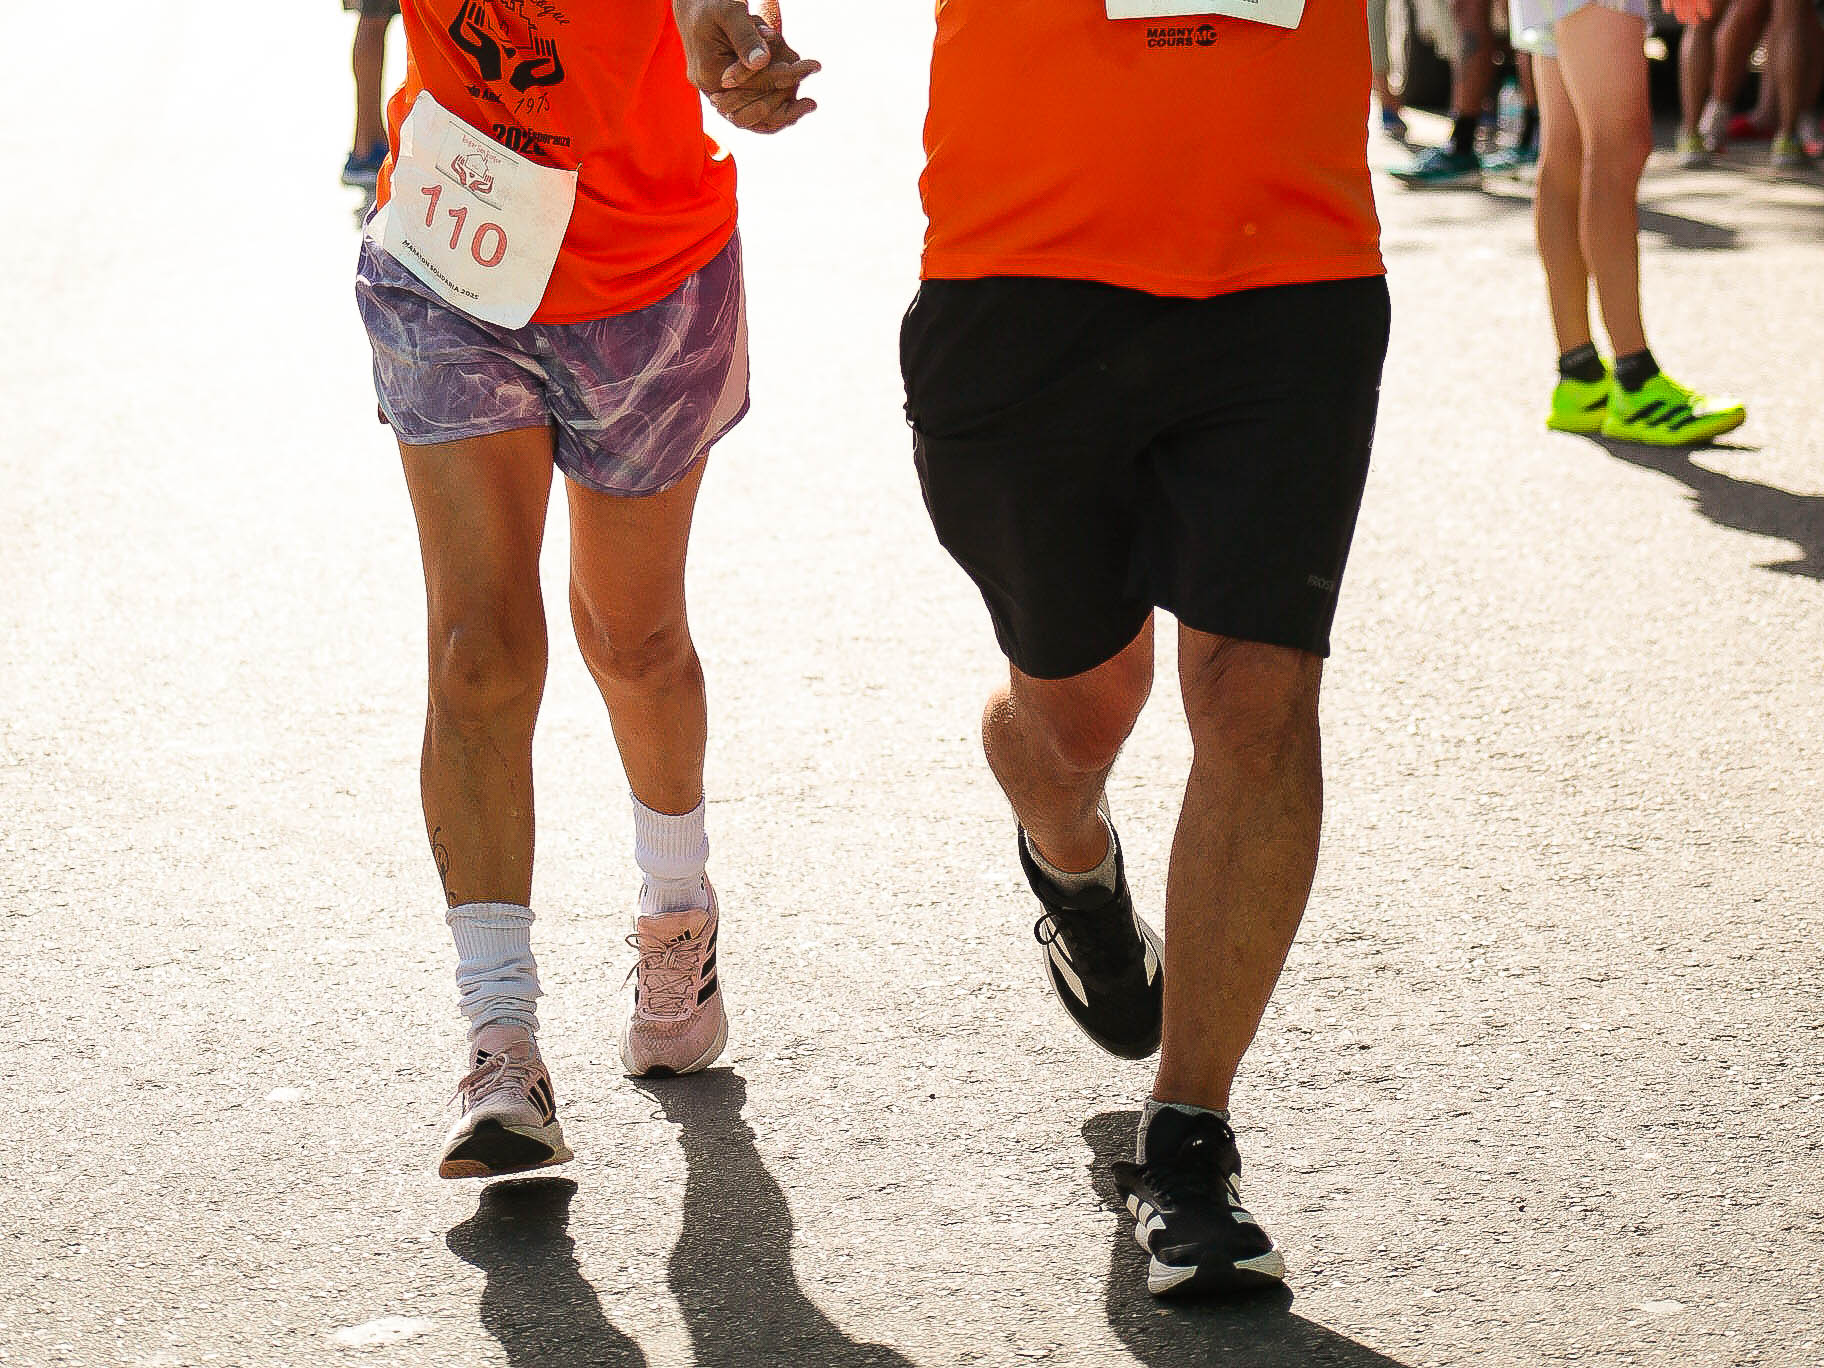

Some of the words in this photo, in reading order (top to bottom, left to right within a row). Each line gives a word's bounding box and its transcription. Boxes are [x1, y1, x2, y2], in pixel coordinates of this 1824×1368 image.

[1147, 27, 1194, 38] MAGNY
[1147, 37, 1194, 48] COURS
[421, 183, 508, 268] 110
[401, 239, 430, 268] MARATON
[430, 263, 460, 293] SOLIDARIA
[460, 288, 480, 300] 2025
